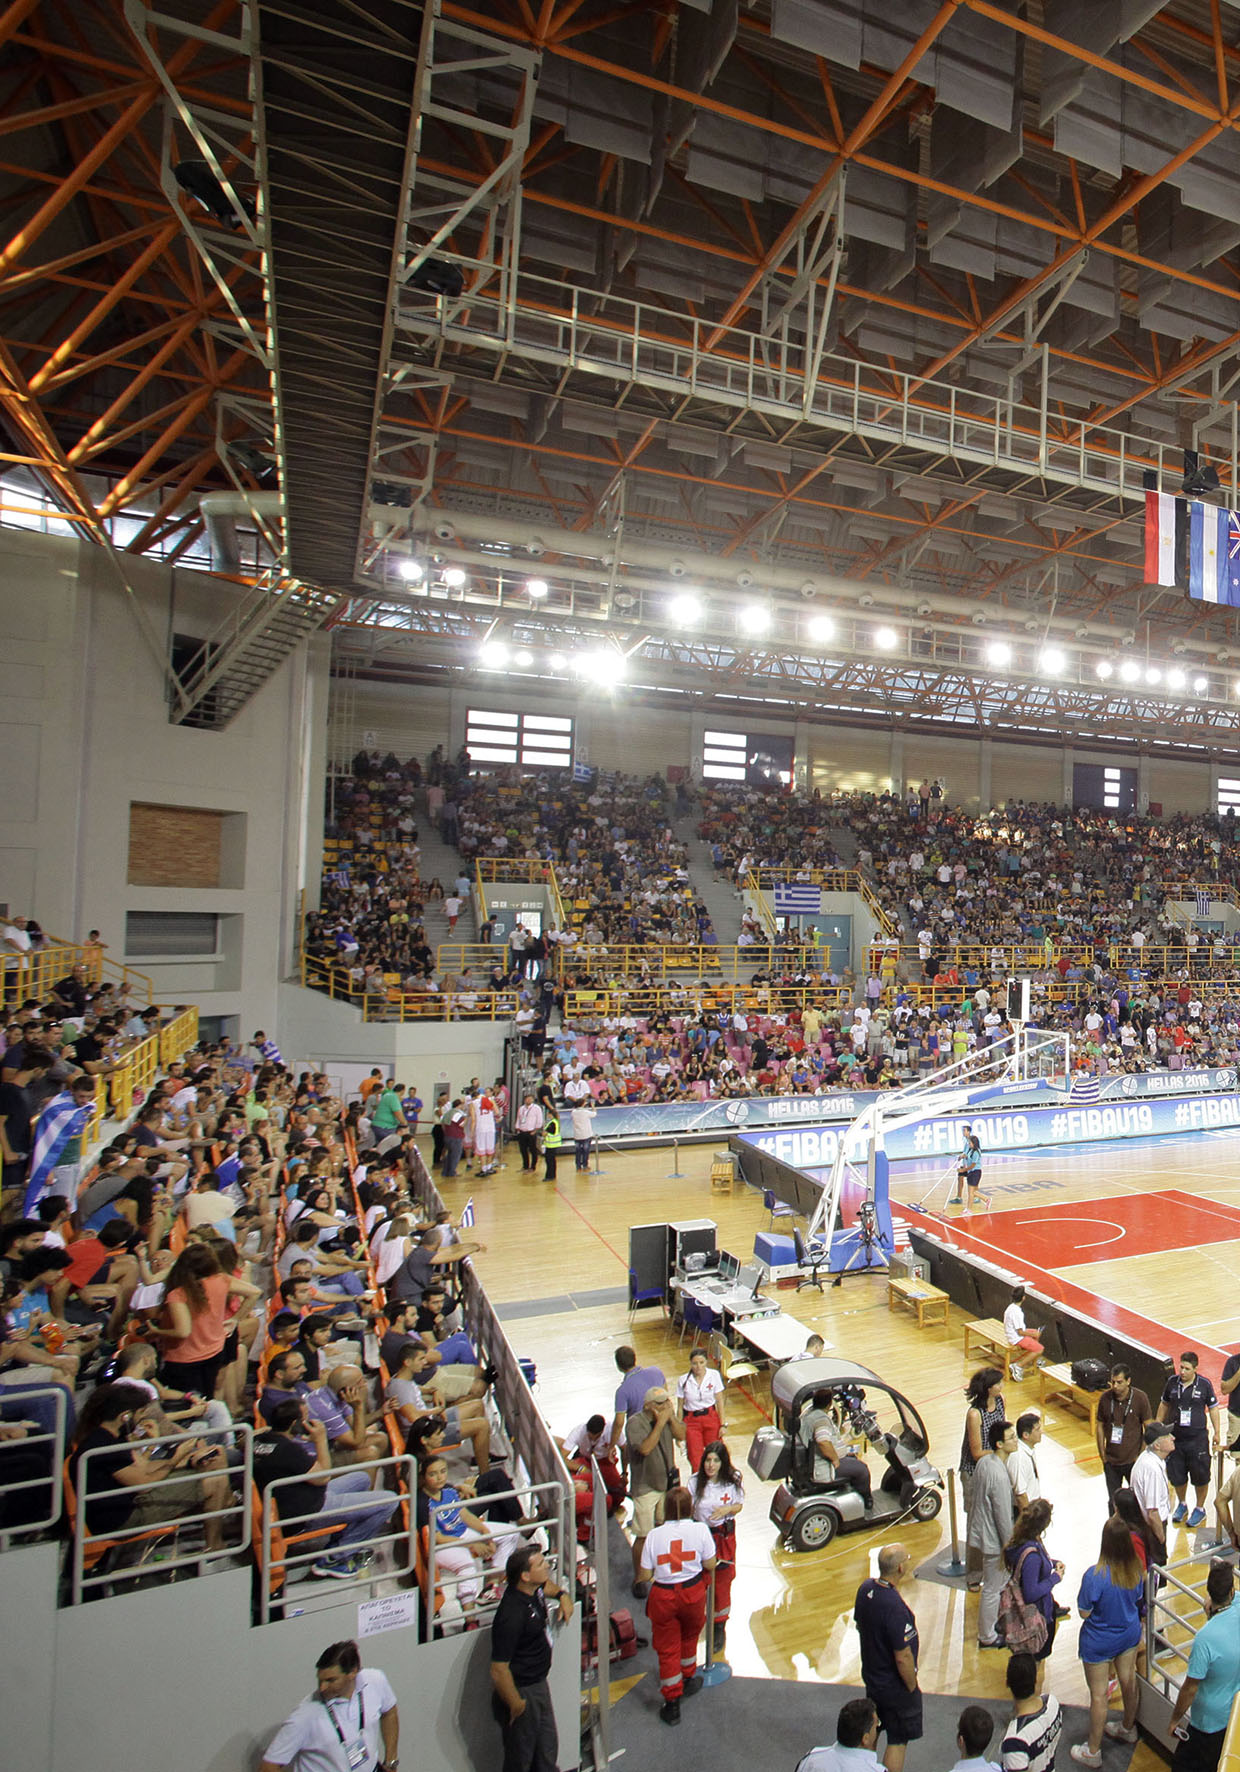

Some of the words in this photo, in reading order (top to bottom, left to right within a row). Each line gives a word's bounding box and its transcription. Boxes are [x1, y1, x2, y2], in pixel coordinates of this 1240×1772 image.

[1147, 1076, 1183, 1091] HELLAS
[768, 1100, 819, 1119] HELLAS
[1051, 1105, 1153, 1139] #FIBAU19
[978, 1180, 1067, 1196] FIBA
